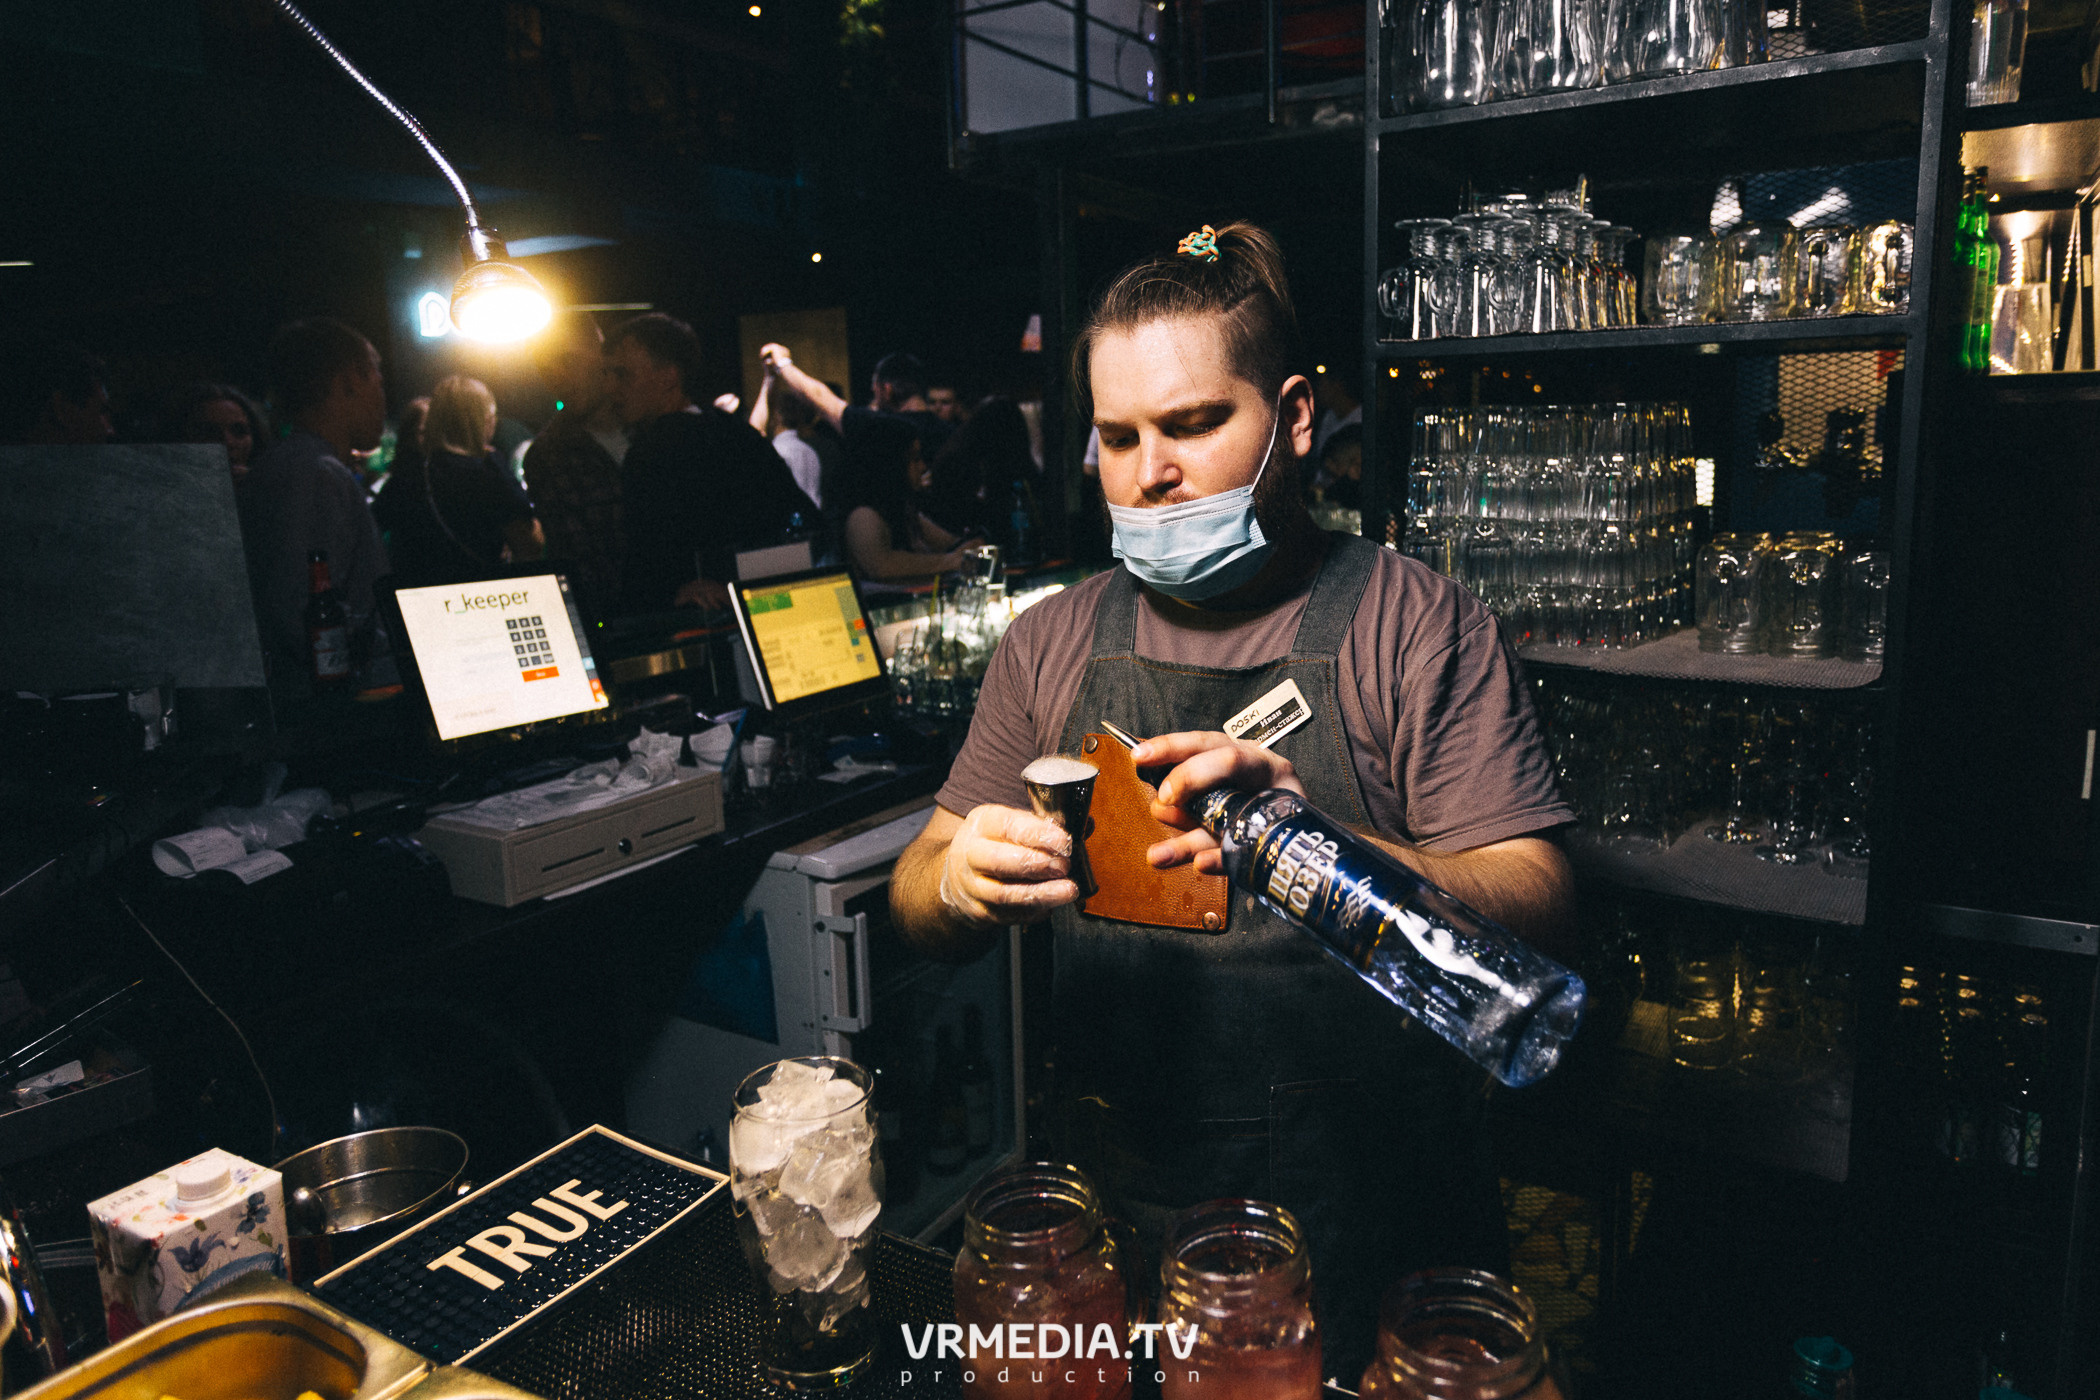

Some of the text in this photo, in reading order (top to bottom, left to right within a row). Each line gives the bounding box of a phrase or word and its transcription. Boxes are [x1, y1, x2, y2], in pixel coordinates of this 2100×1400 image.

[444, 591, 528, 614] r_keeper
[1231, 709, 1260, 733] DOSKI
[1255, 707, 1305, 743] рмен-стажер
[1260, 709, 1283, 728] Иван
[1268, 830, 1325, 902] ПЯТЬ
[1290, 840, 1339, 912] ОЗЕР
[426, 1178, 630, 1291] TRUE
